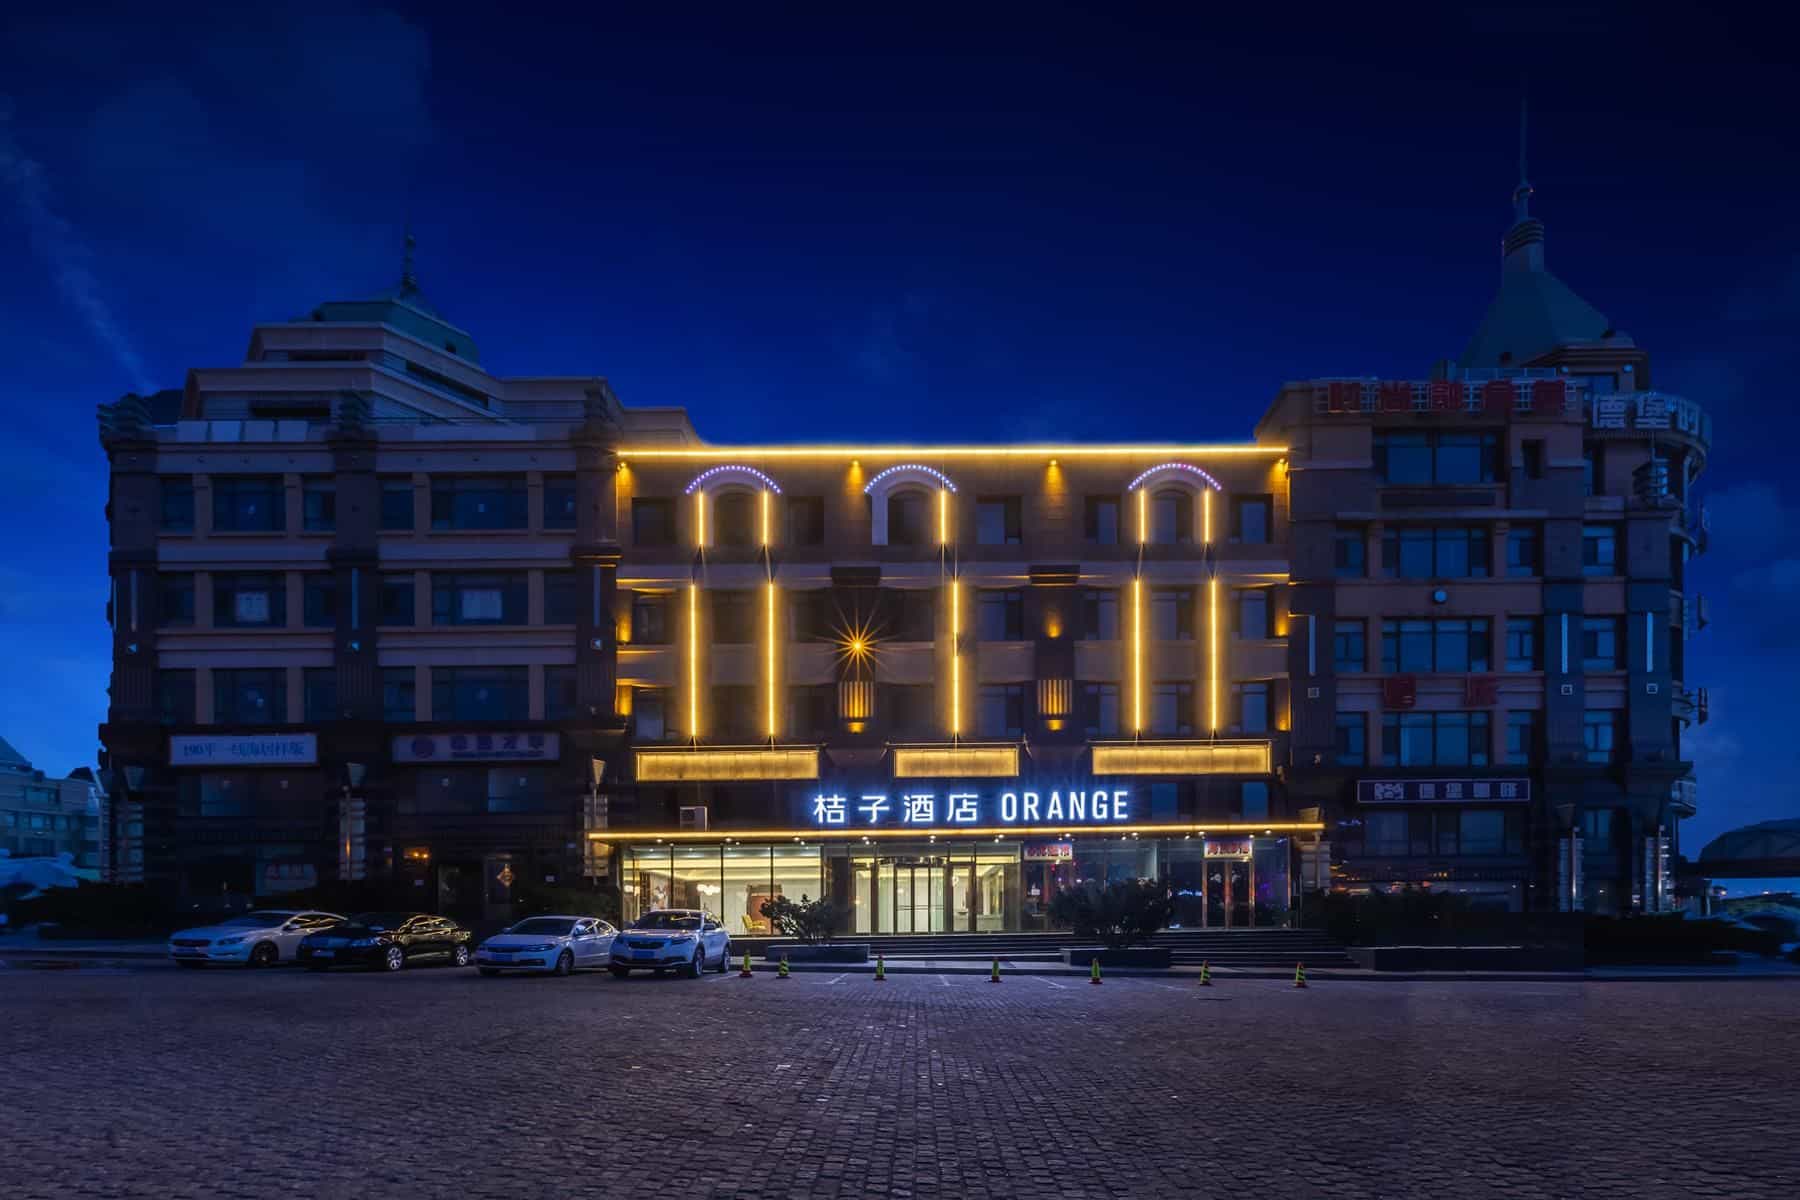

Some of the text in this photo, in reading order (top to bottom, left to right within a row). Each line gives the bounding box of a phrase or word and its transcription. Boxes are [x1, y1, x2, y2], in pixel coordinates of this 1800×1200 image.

[813, 790, 1129, 824] 桔子酒店 ORANGE
